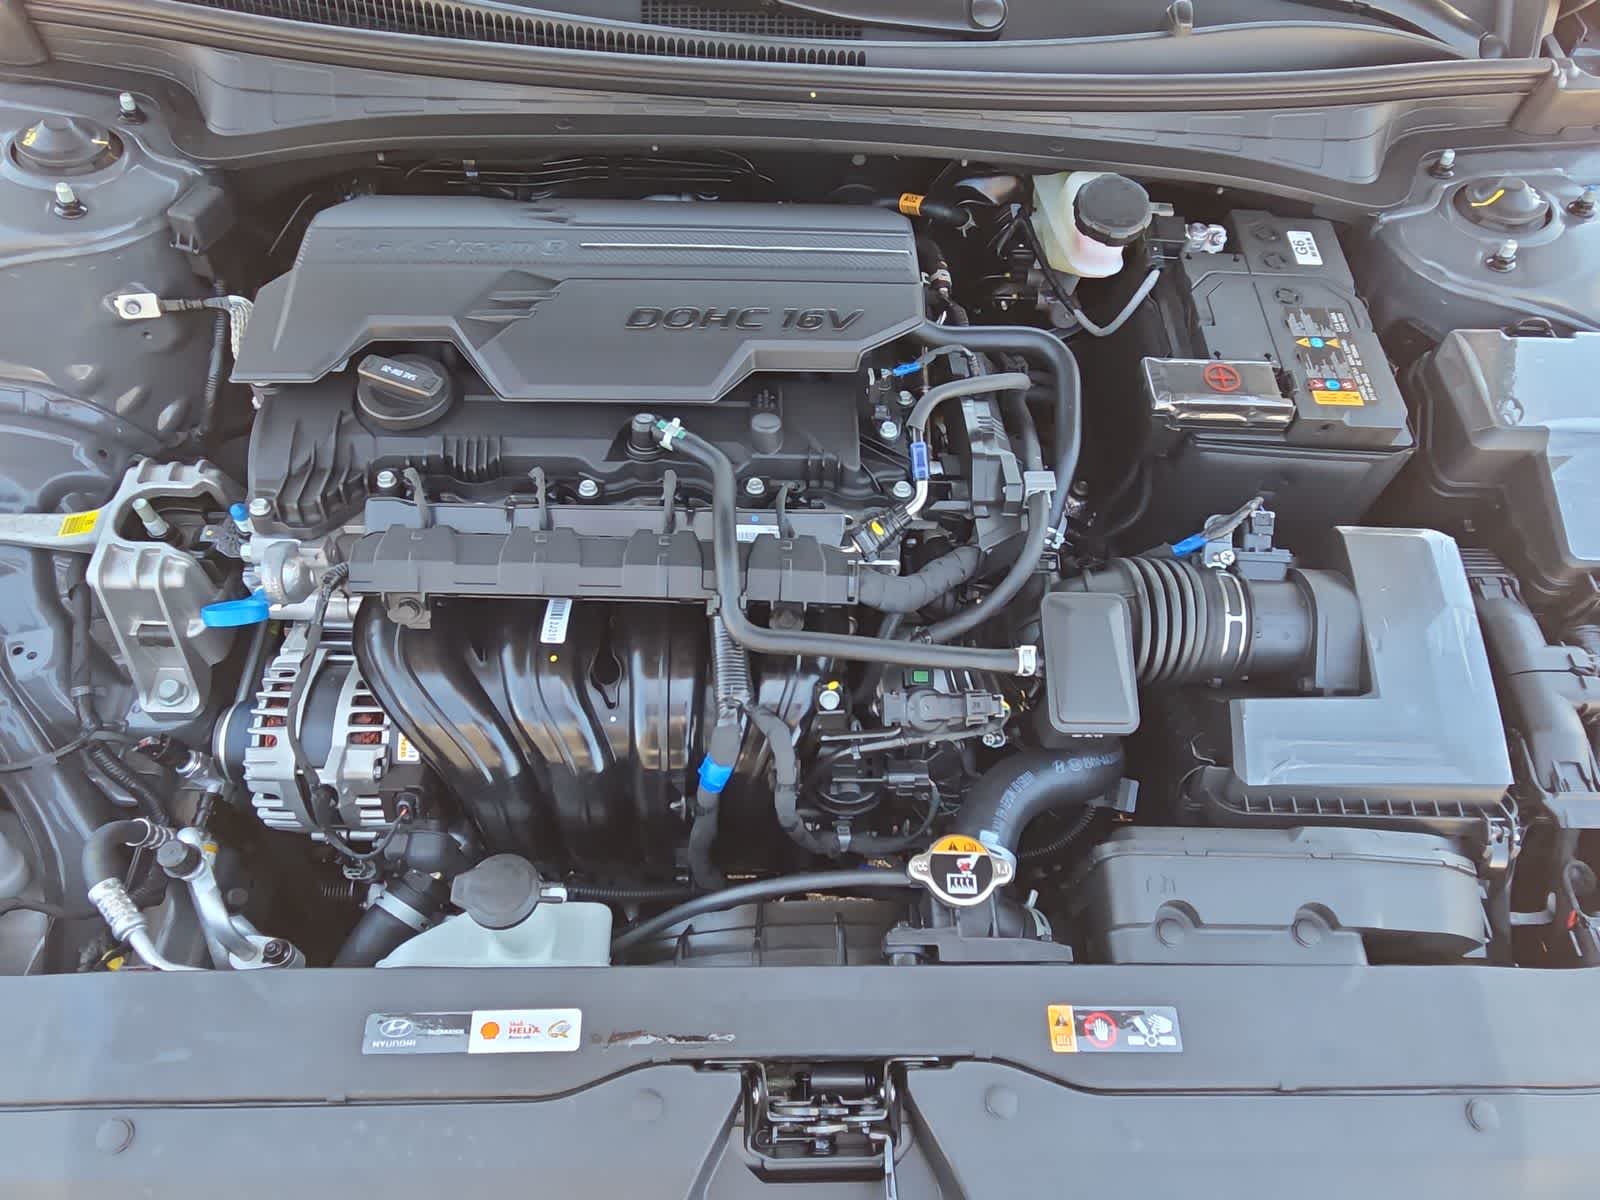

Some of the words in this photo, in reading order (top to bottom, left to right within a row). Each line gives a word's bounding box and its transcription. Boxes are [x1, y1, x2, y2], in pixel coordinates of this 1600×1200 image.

[624, 306, 770, 331] DOHC
[782, 307, 865, 331] 16V
[508, 1026, 541, 1034] HELIX
